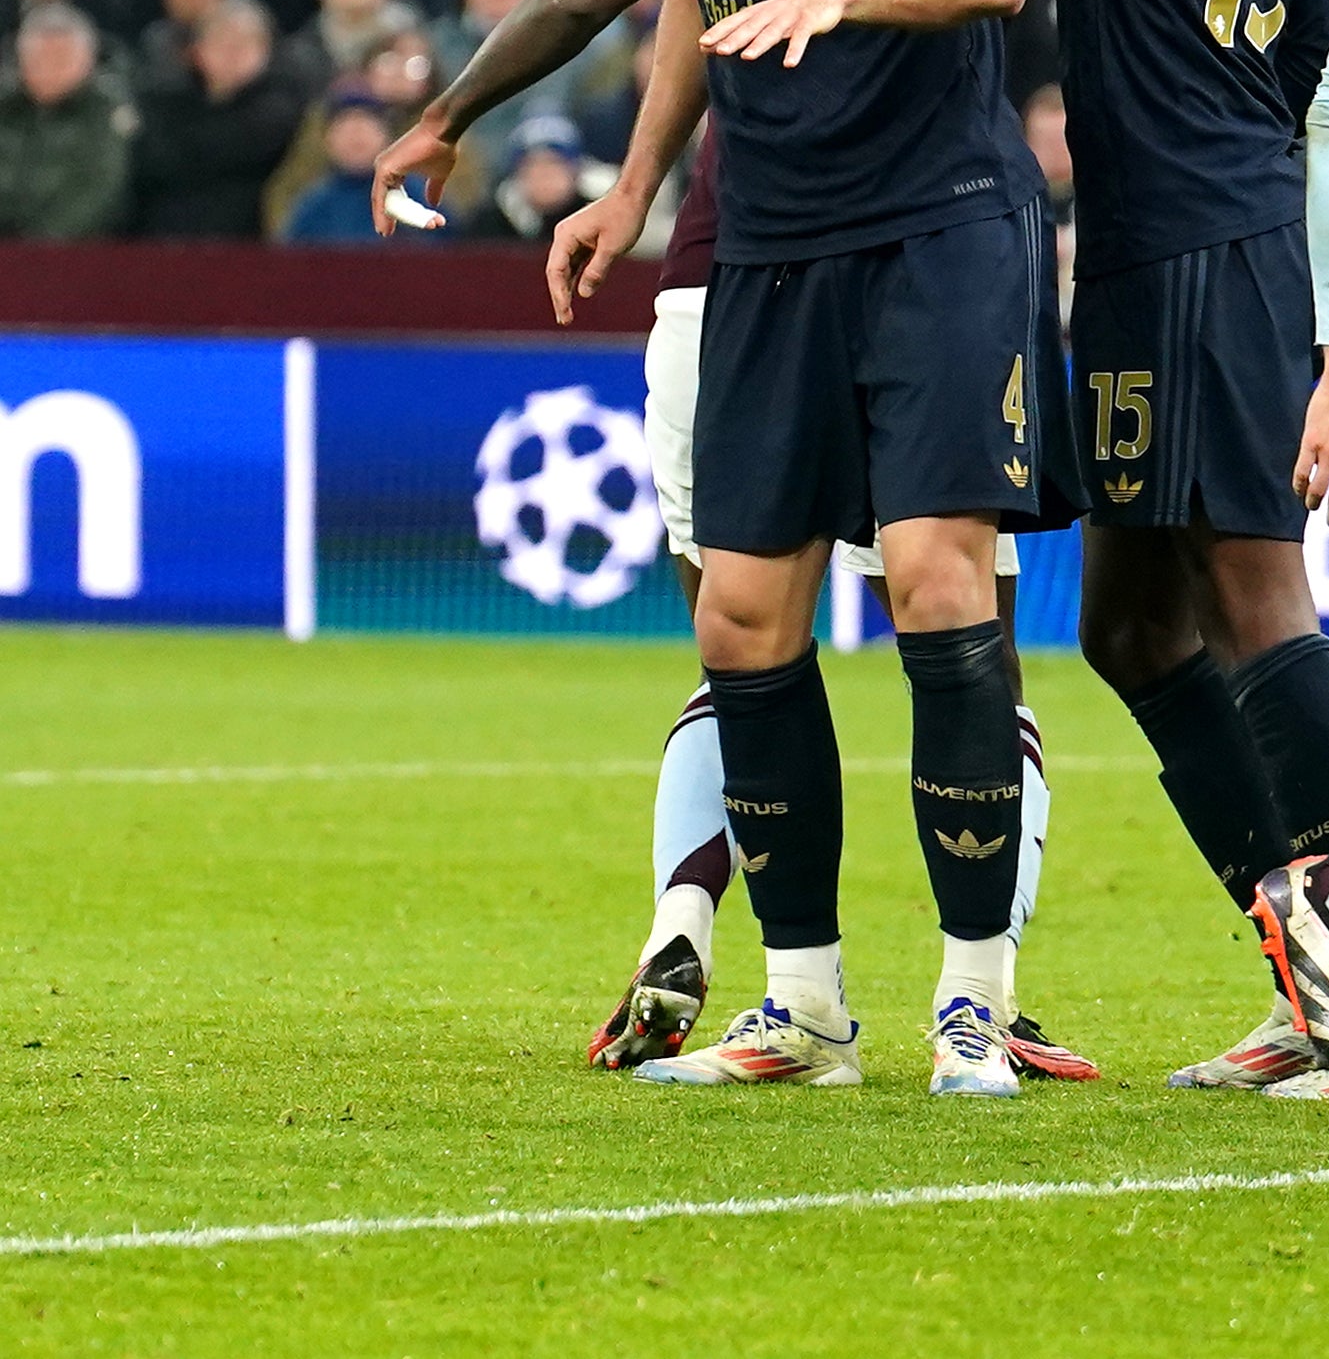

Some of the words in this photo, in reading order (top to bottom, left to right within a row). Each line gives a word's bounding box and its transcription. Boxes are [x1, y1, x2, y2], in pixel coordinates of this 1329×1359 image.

[1002, 353, 1027, 444] 4
[1089, 371, 1154, 460] 15
[913, 776, 1020, 802] JUVENTUS
